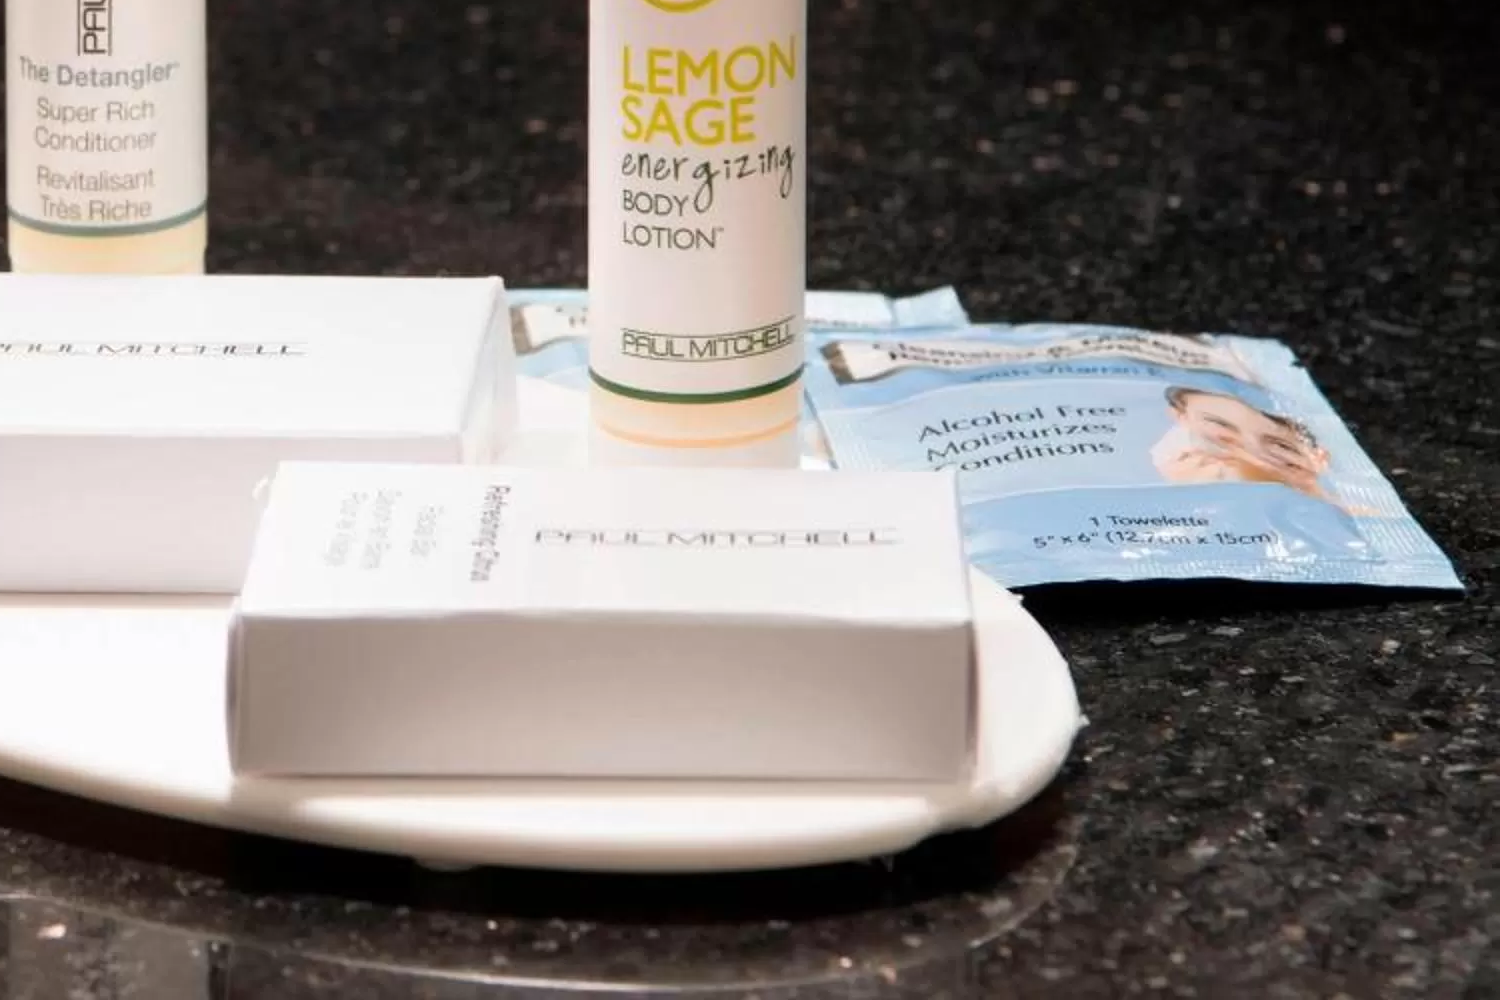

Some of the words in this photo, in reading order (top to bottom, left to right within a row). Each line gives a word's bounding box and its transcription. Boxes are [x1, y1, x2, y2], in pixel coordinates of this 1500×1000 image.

[19, 56, 49, 83] The
[622, 34, 796, 97] LEMON
[36, 96, 99, 124] Super
[106, 100, 156, 122] Rich
[620, 93, 757, 147] SAGE
[34, 125, 157, 153] Conditioner
[36, 165, 157, 193] Revitalisant
[621, 144, 795, 213] energizing
[89, 199, 153, 222] Riche
[622, 189, 689, 217] BODY
[622, 331, 685, 358] PAUL
[689, 324, 795, 358] MITCHELL
[918, 406, 1045, 443] Alcohol
[1056, 405, 1128, 418] Free
[926, 422, 1118, 463] Moisturizes
[1089, 516, 1100, 528] 1
[1106, 514, 1210, 528] Towelette
